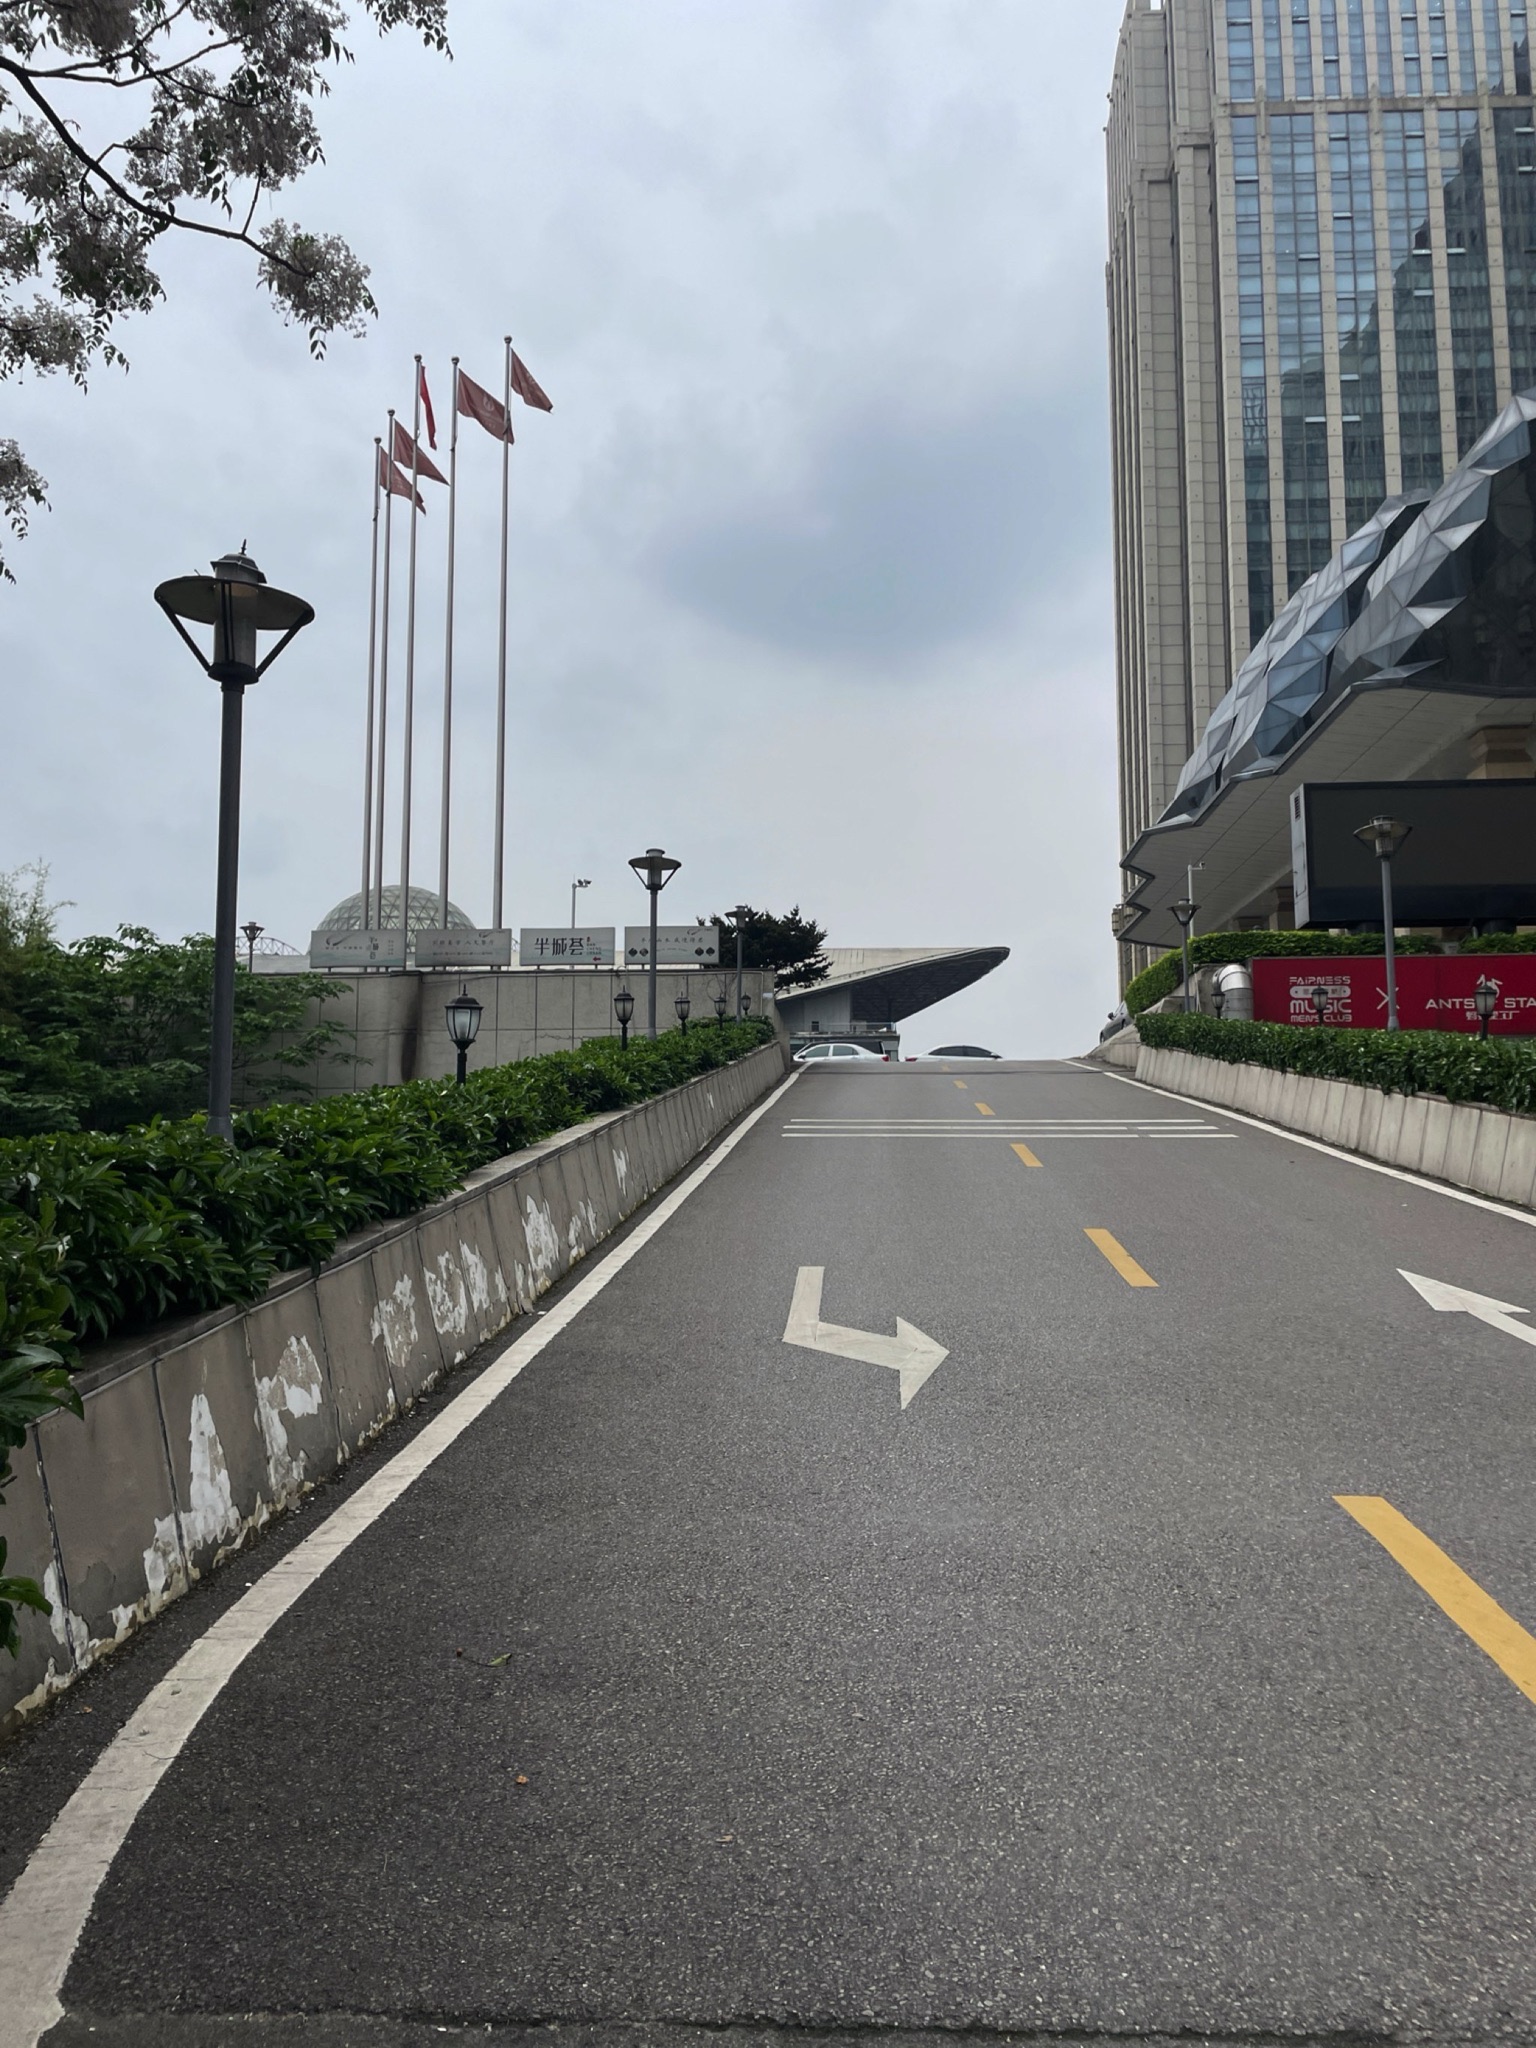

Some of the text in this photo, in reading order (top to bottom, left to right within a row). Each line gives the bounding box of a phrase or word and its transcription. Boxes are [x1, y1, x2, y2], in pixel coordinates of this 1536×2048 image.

[534, 937, 584, 956] 半城荟
[1289, 1000, 1352, 1013] MUSIC
[1425, 998, 1476, 1009] ANTS
[1323, 1014, 1353, 1022] CLUB
